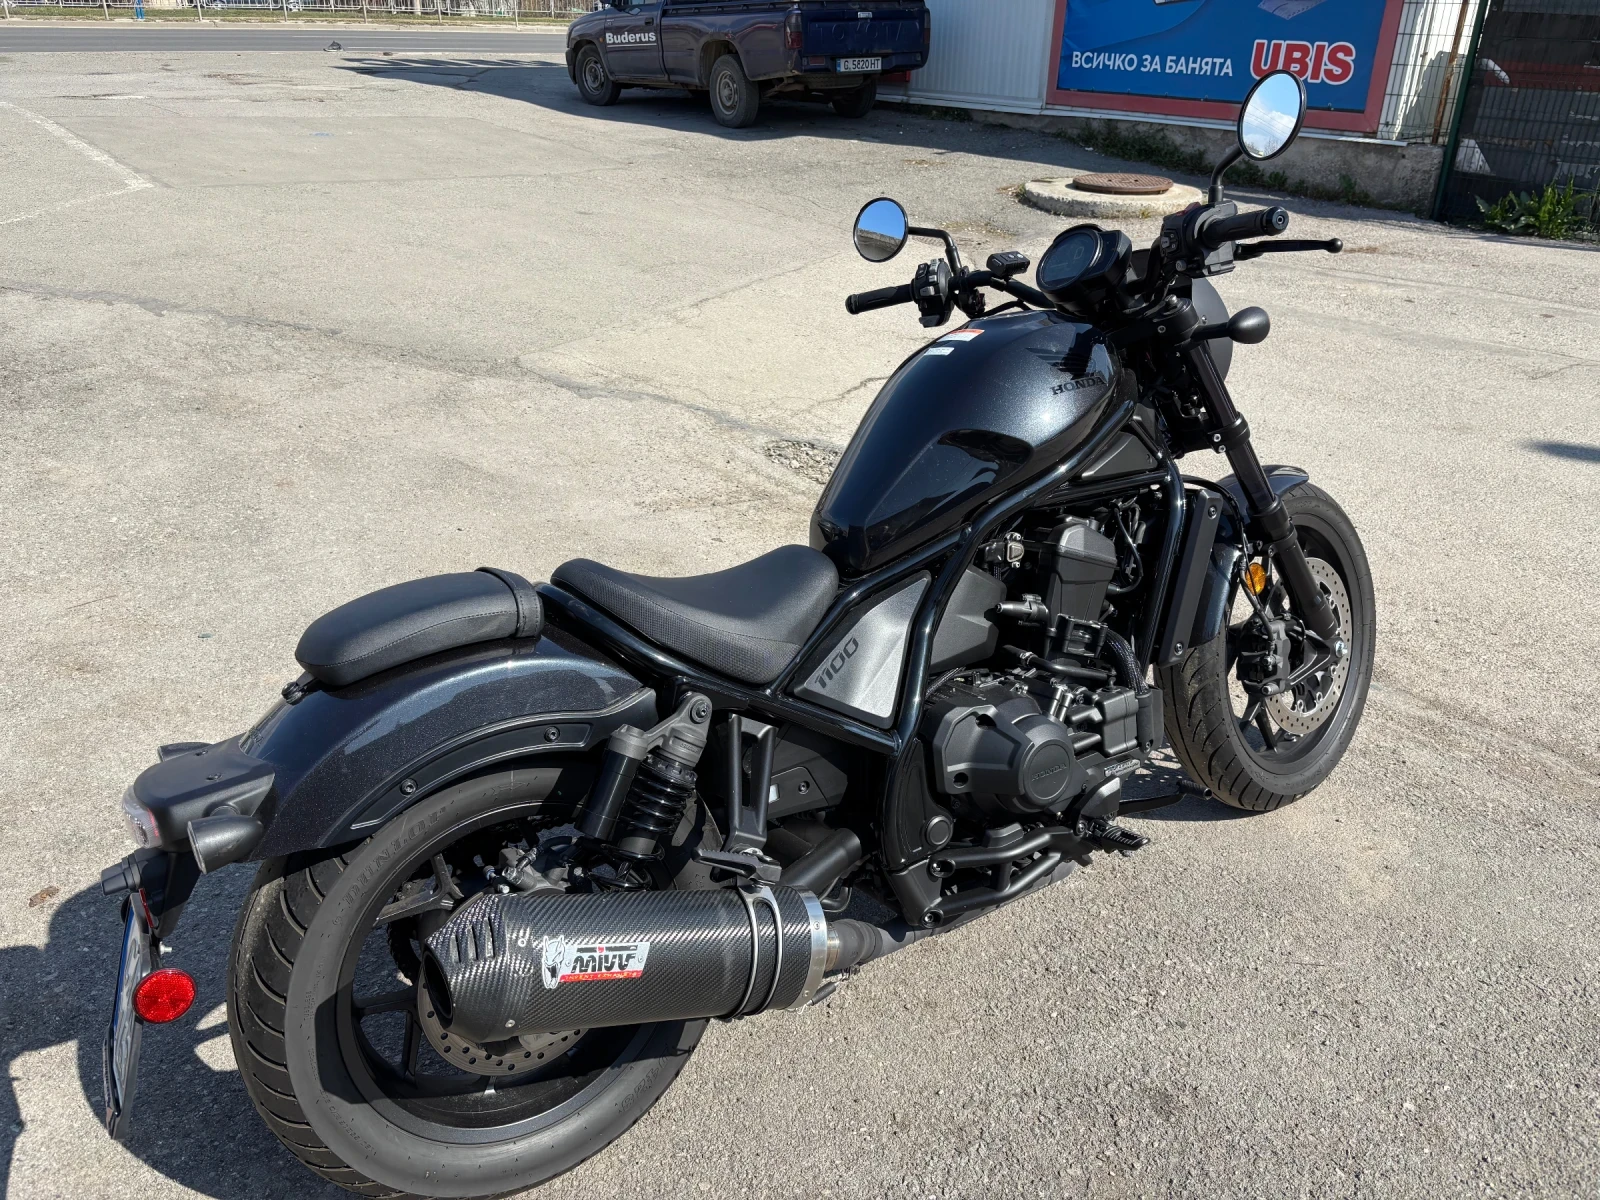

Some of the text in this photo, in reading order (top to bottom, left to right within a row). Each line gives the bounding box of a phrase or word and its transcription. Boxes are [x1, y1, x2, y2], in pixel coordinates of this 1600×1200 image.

[605, 31, 657, 44] Buderus
[1071, 51, 1233, 77] ВСИЧКО ЗА БАНЯТА
[1250, 40, 1356, 85] UBIS
[1050, 376, 1107, 396] HONDA
[814, 636, 859, 689] 1100
